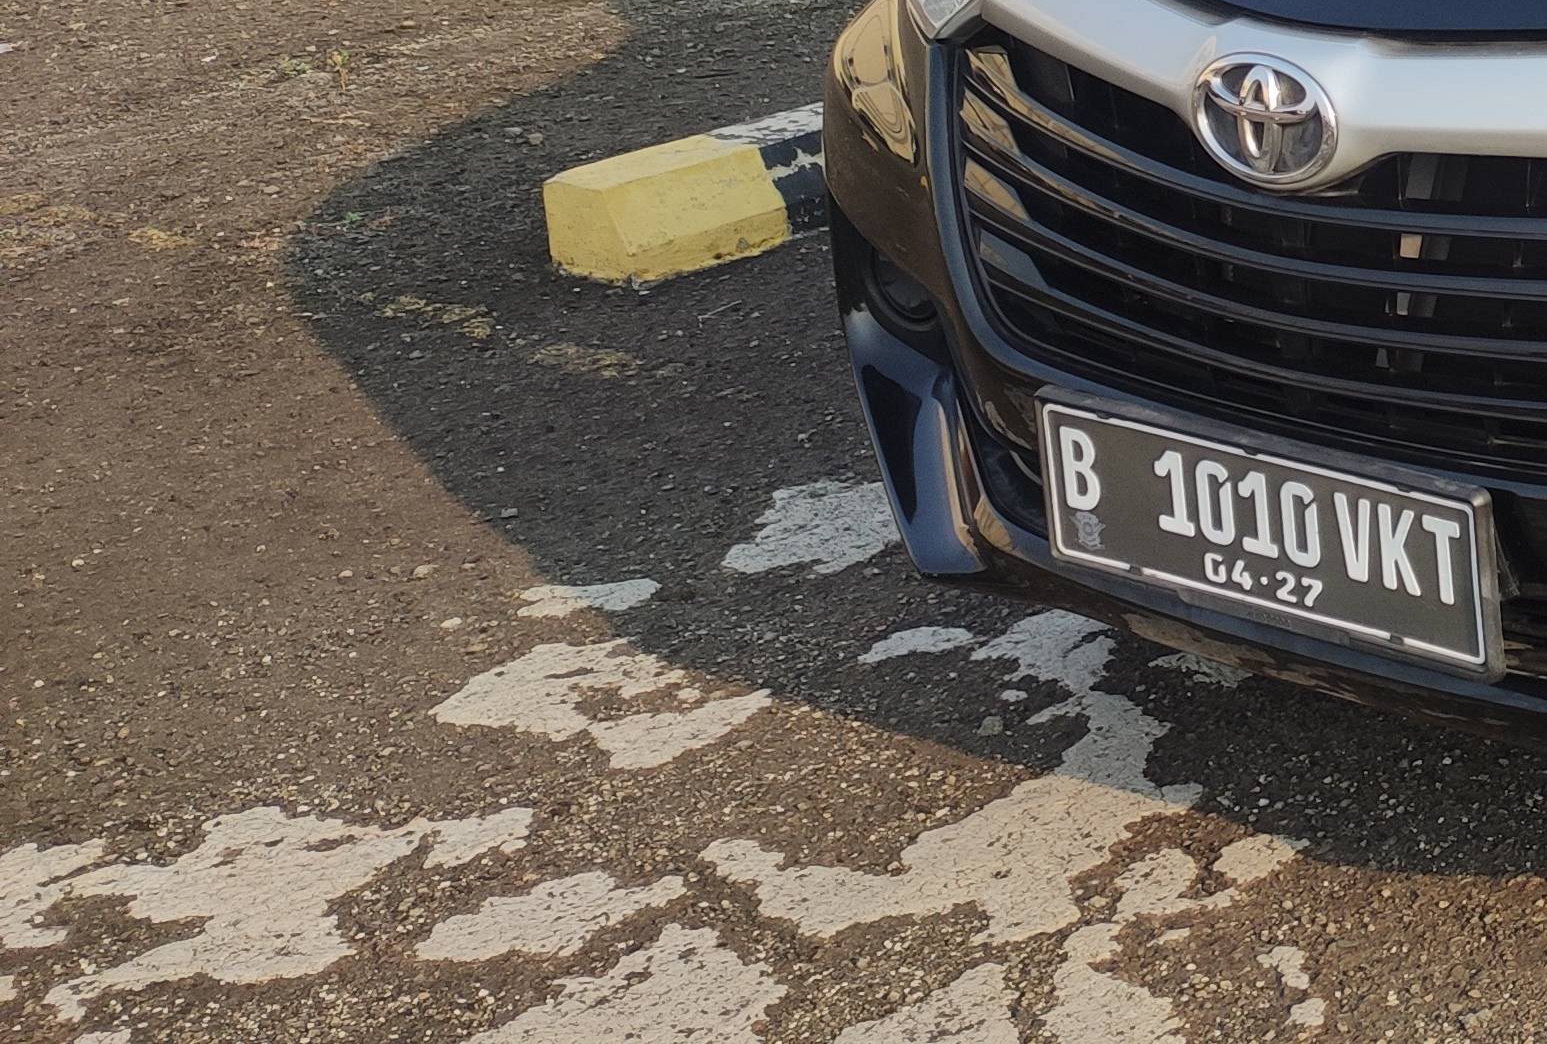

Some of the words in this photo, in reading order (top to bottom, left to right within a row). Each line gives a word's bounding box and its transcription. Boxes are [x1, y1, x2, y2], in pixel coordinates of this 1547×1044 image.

[1059, 425, 1101, 512] B
[1153, 449, 1322, 569] 1010
[1333, 491, 1461, 606] VKT
